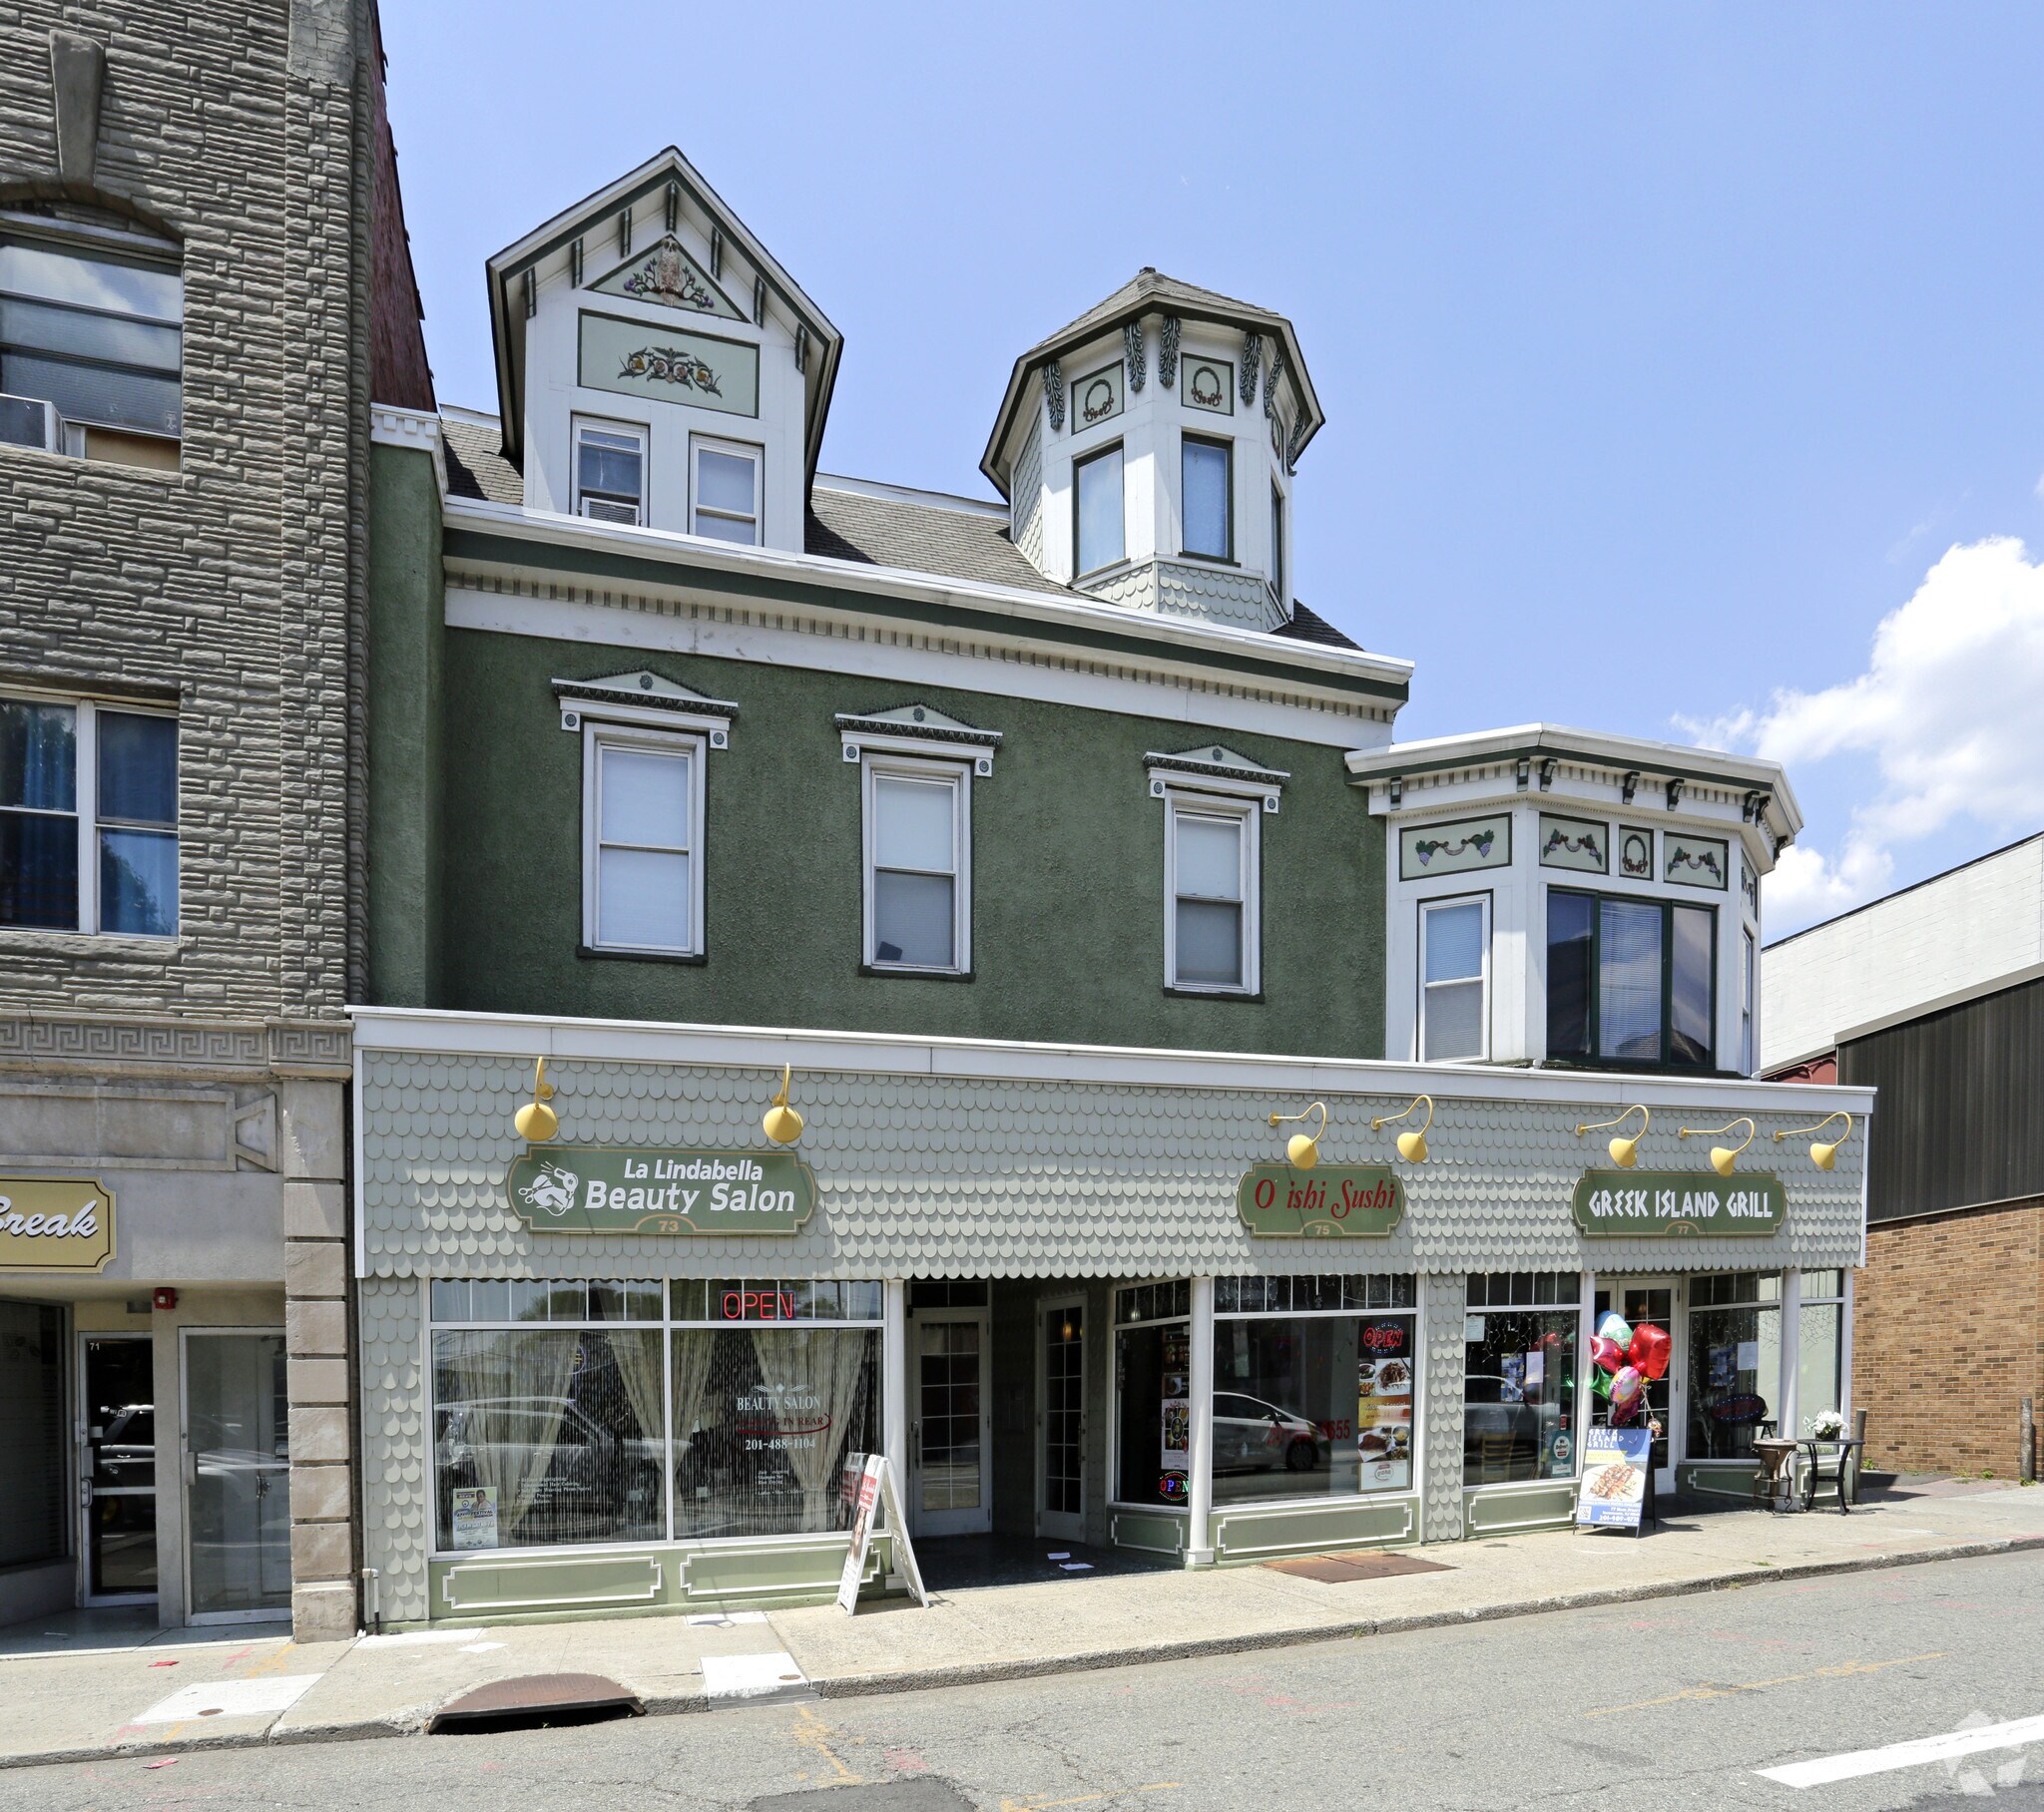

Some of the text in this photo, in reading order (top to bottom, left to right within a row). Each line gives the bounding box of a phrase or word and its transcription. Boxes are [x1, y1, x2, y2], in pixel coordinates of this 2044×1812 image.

[624, 1158, 764, 1180] La Lindabella
[584, 1180, 795, 1214] Beauty Salon
[1330, 1179, 1395, 1219] Sushi
[1588, 1189, 1773, 1218] GREEK ISLAND GRILL
[658, 1220, 679, 1232] 73
[1314, 1225, 1330, 1235] 75
[1677, 1225, 1690, 1234] 77
[724, 1292, 794, 1320] OPEN
[1363, 1326, 1404, 1347] OPEN
[89, 1342, 101, 1352] 71
[737, 1396, 821, 1412] BEAUTY SALON
[798, 1416, 823, 1426] REAR
[745, 1437, 816, 1451] 201-488-1104
[1160, 1480, 1189, 1493] OPEN
